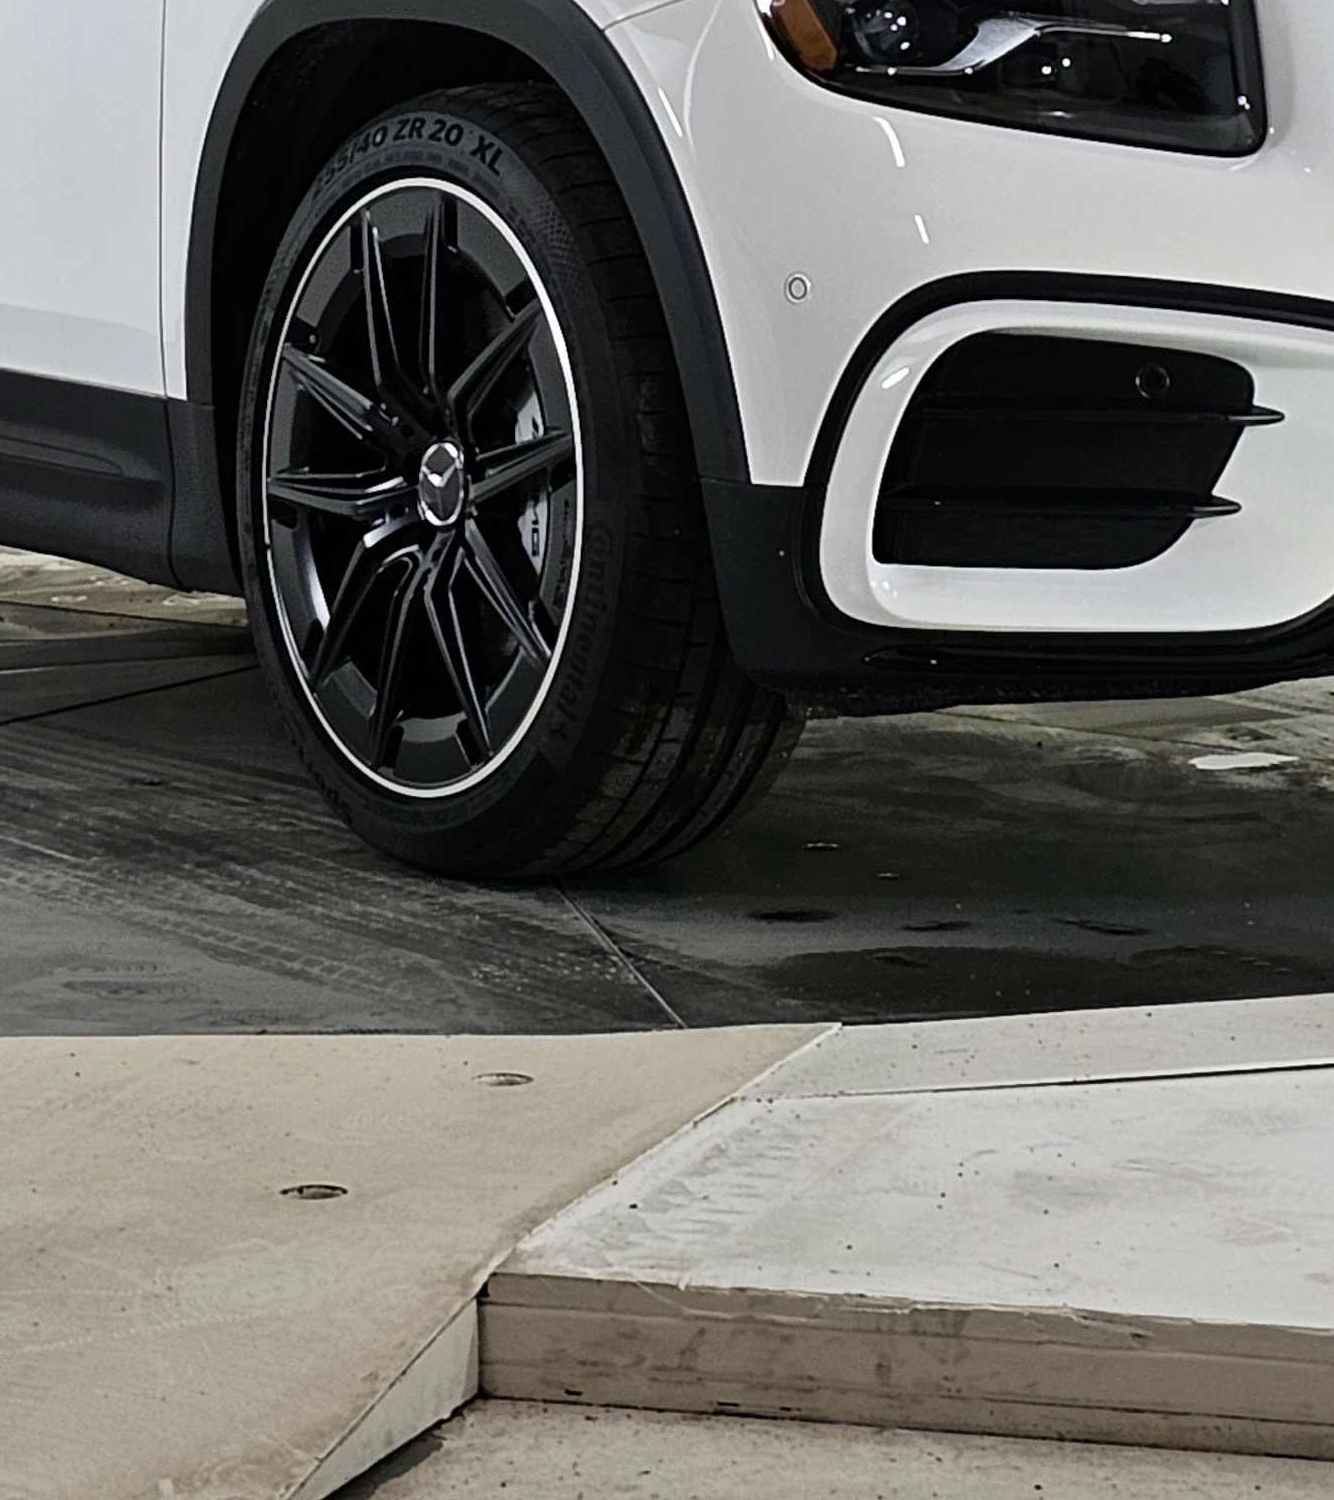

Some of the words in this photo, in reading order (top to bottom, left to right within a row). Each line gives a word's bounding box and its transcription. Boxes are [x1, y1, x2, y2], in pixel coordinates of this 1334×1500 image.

[392, 117, 426, 142] ZR
[427, 118, 464, 147] 20
[469, 135, 504, 177] XL
[556, 522, 614, 720] Continental
